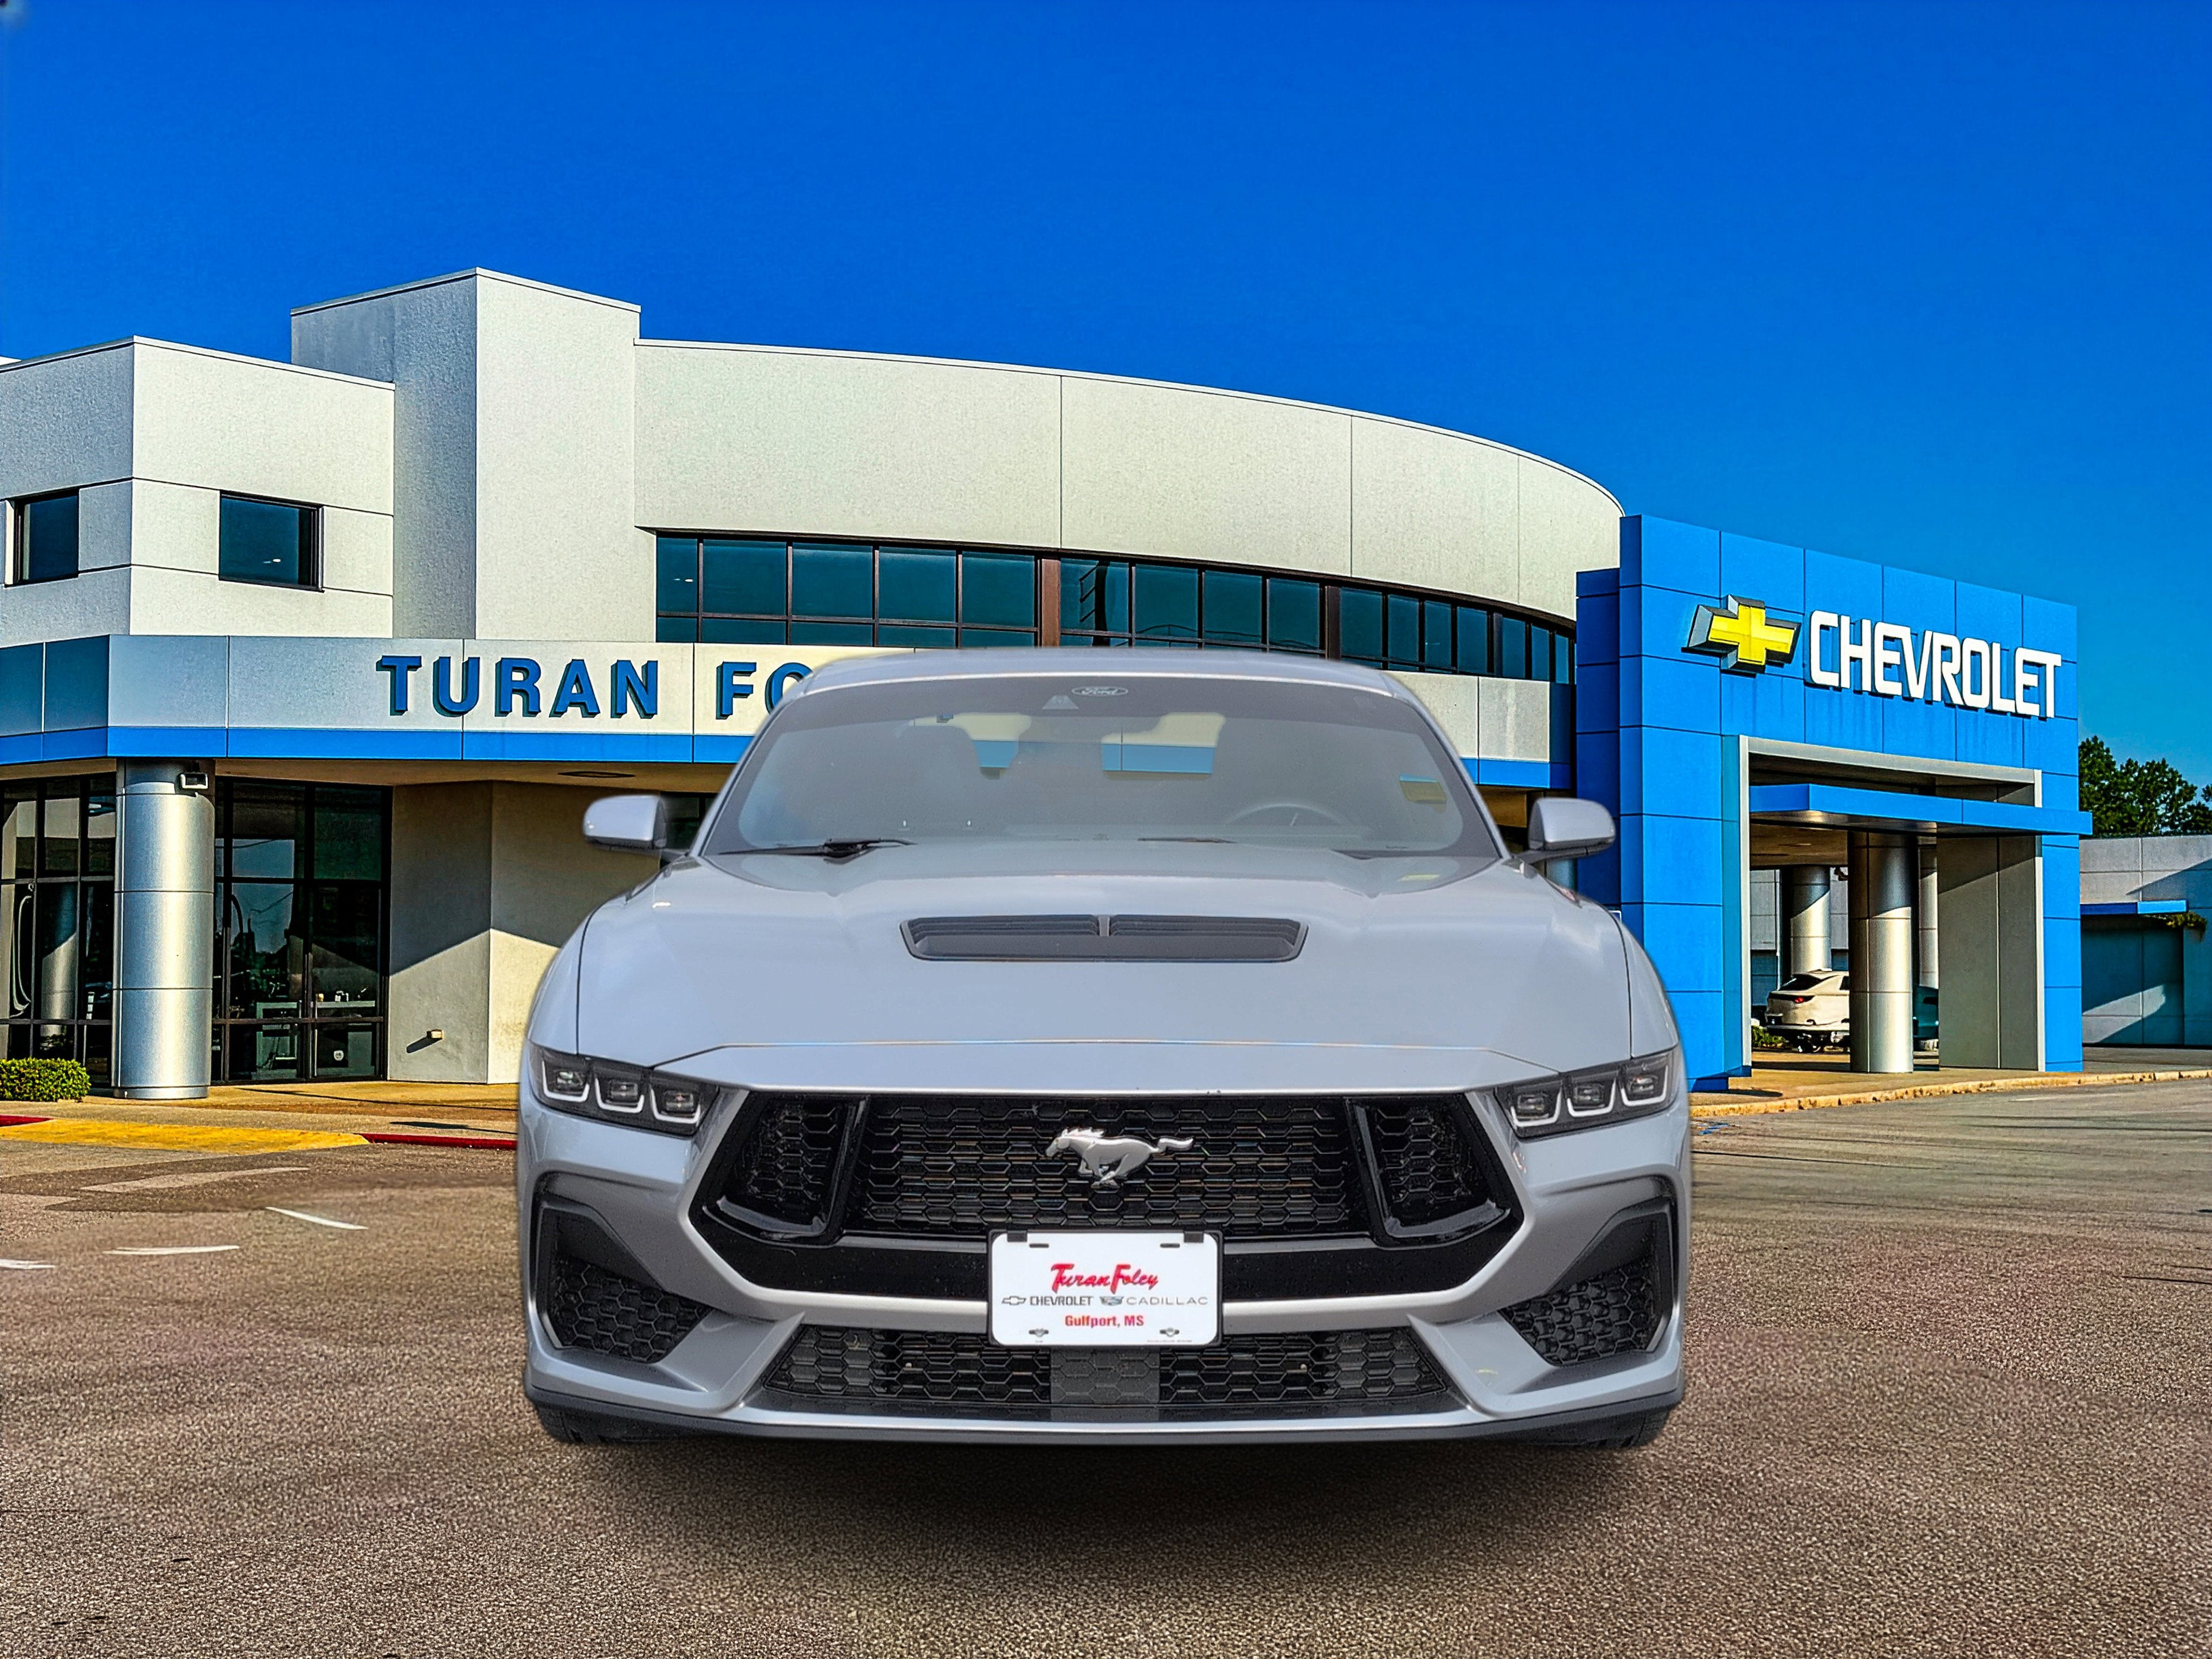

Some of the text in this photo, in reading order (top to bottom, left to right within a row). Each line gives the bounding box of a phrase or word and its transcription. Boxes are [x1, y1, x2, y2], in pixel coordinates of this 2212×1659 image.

[1808, 609, 2062, 719] CHEVROLET
[376, 655, 658, 719] TURAN
[1030, 1296, 1208, 1306] CHEVROLET CADILLAC
[1064, 1315, 1144, 1328] Gulfport, MS
